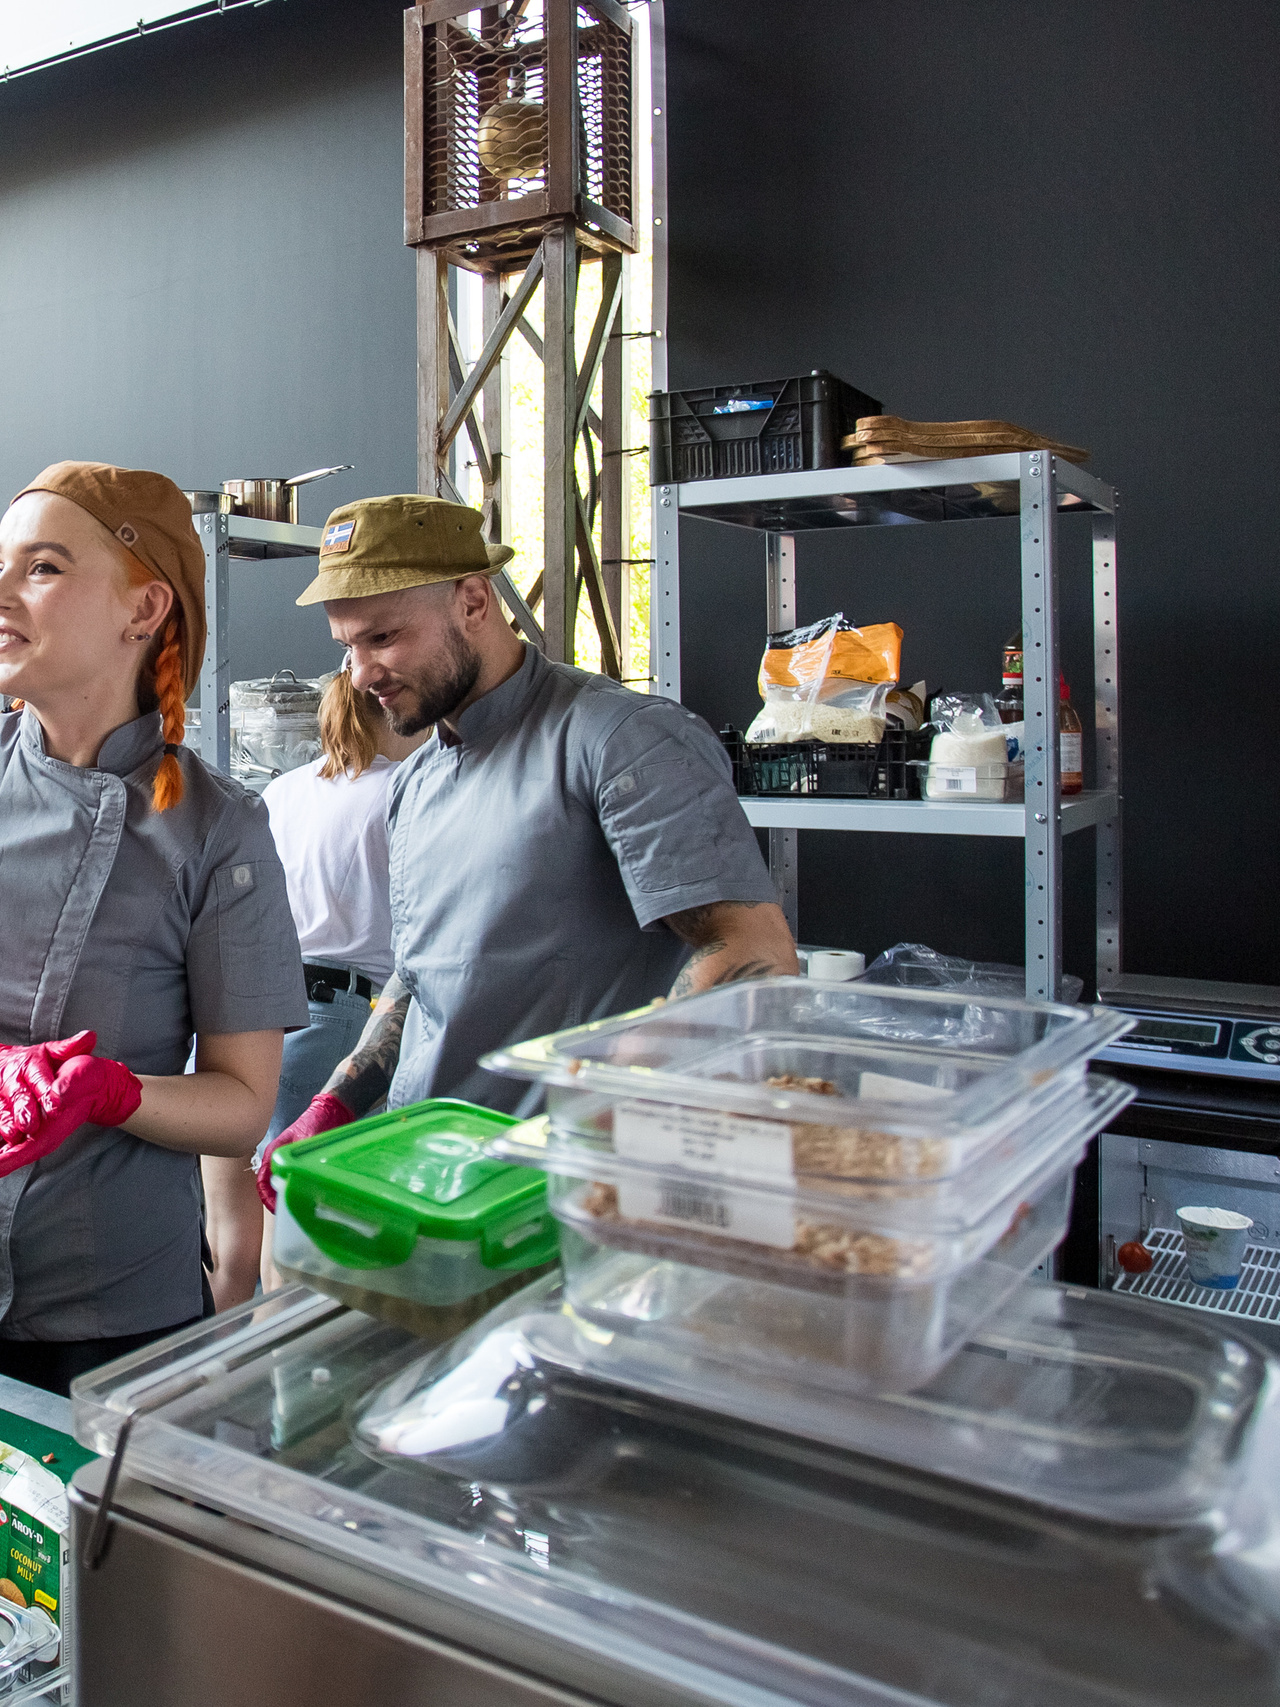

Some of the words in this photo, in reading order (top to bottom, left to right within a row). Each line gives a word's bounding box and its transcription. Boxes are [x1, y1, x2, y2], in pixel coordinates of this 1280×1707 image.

[11, 1518, 43, 1544] AROY-D
[10, 1548, 42, 1574] COCONUT
[16, 1564, 35, 1583] MILK
